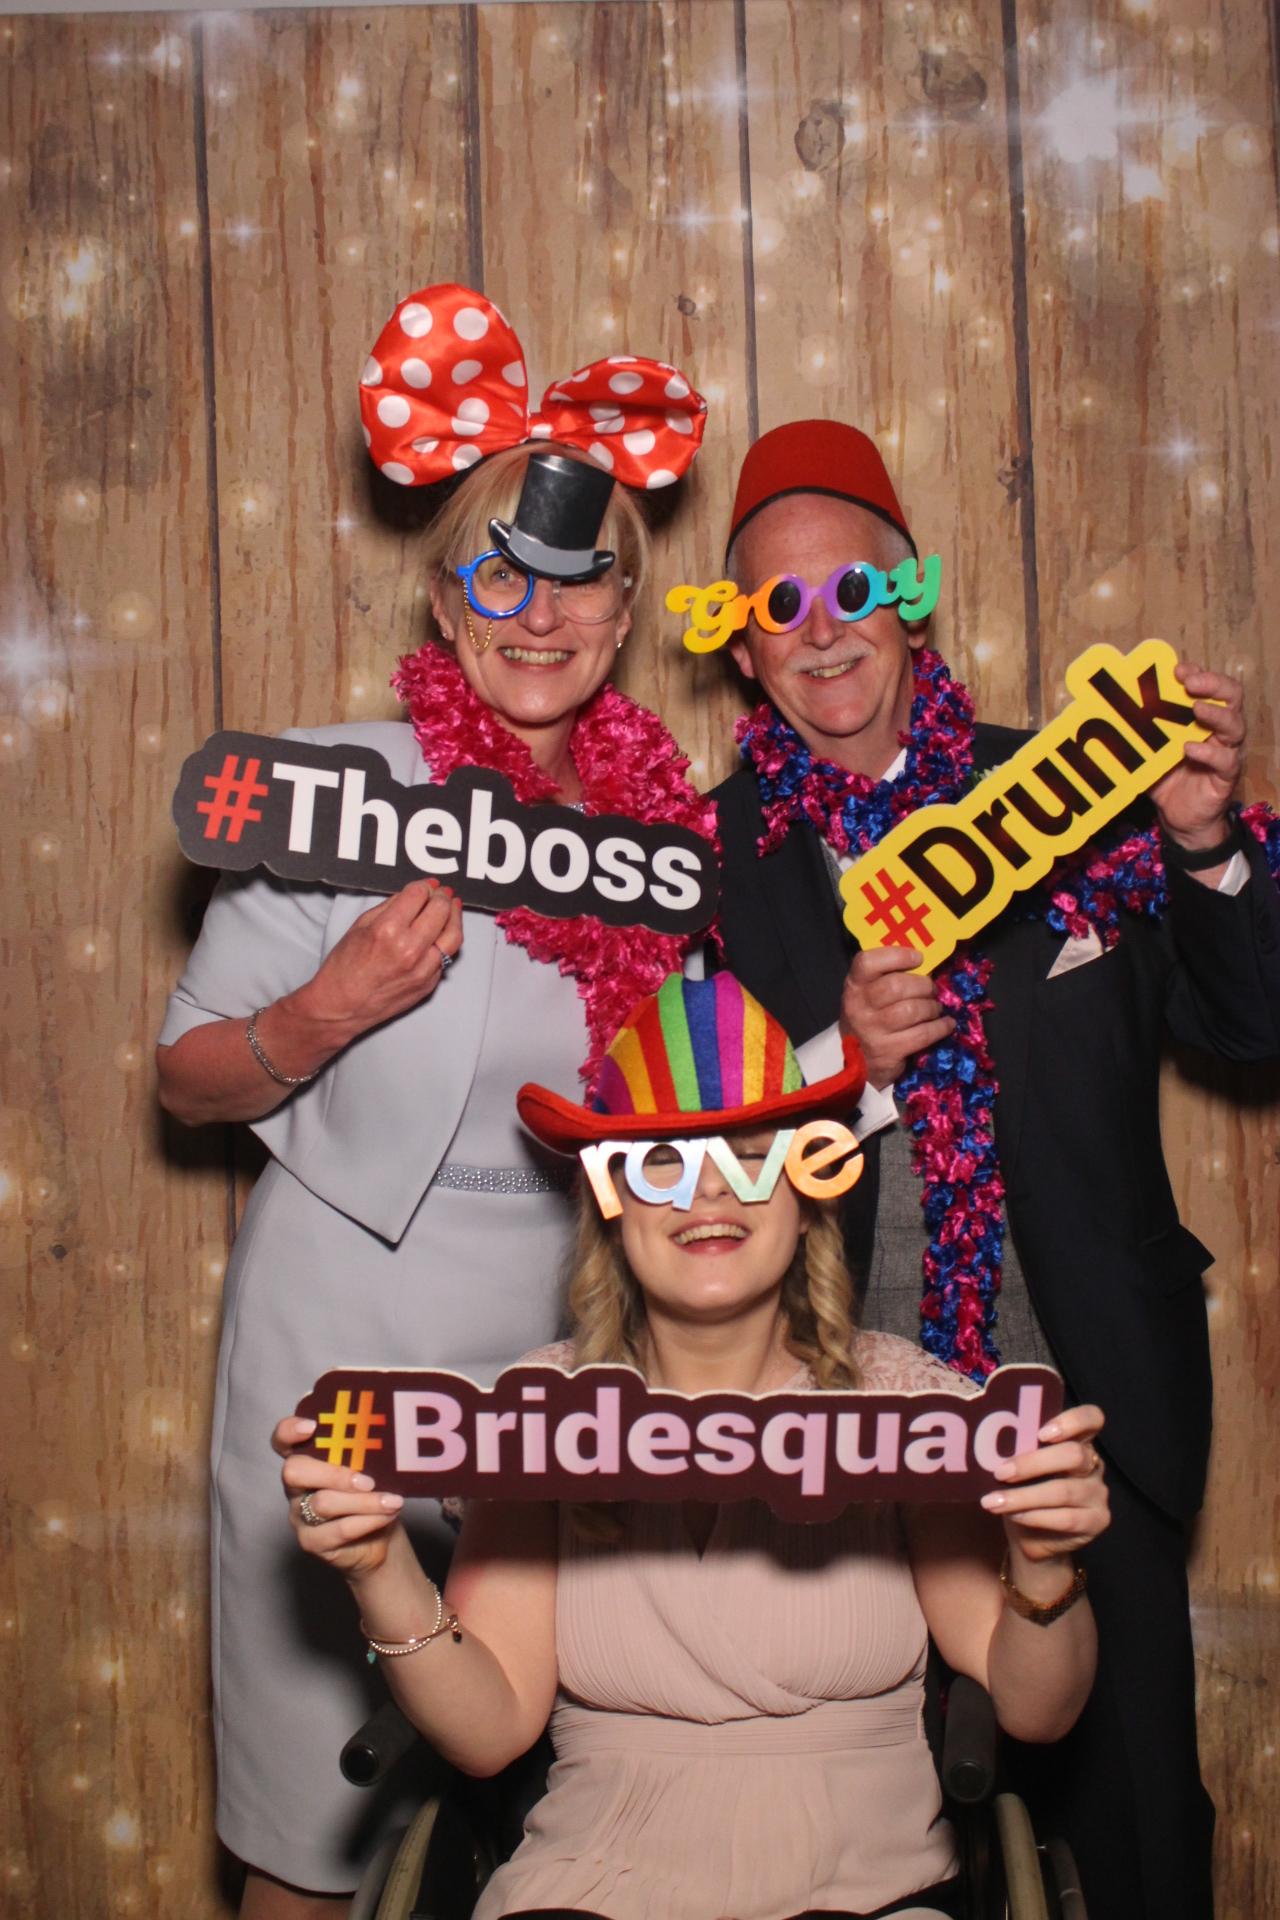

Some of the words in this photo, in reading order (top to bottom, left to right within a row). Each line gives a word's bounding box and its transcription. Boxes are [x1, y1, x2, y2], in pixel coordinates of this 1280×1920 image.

[197, 755, 702, 910] #Theboss
[859, 663, 1198, 949] #Drunk
[579, 1119, 864, 1220] rave
[314, 1386, 1043, 1496] #Bridesquad
